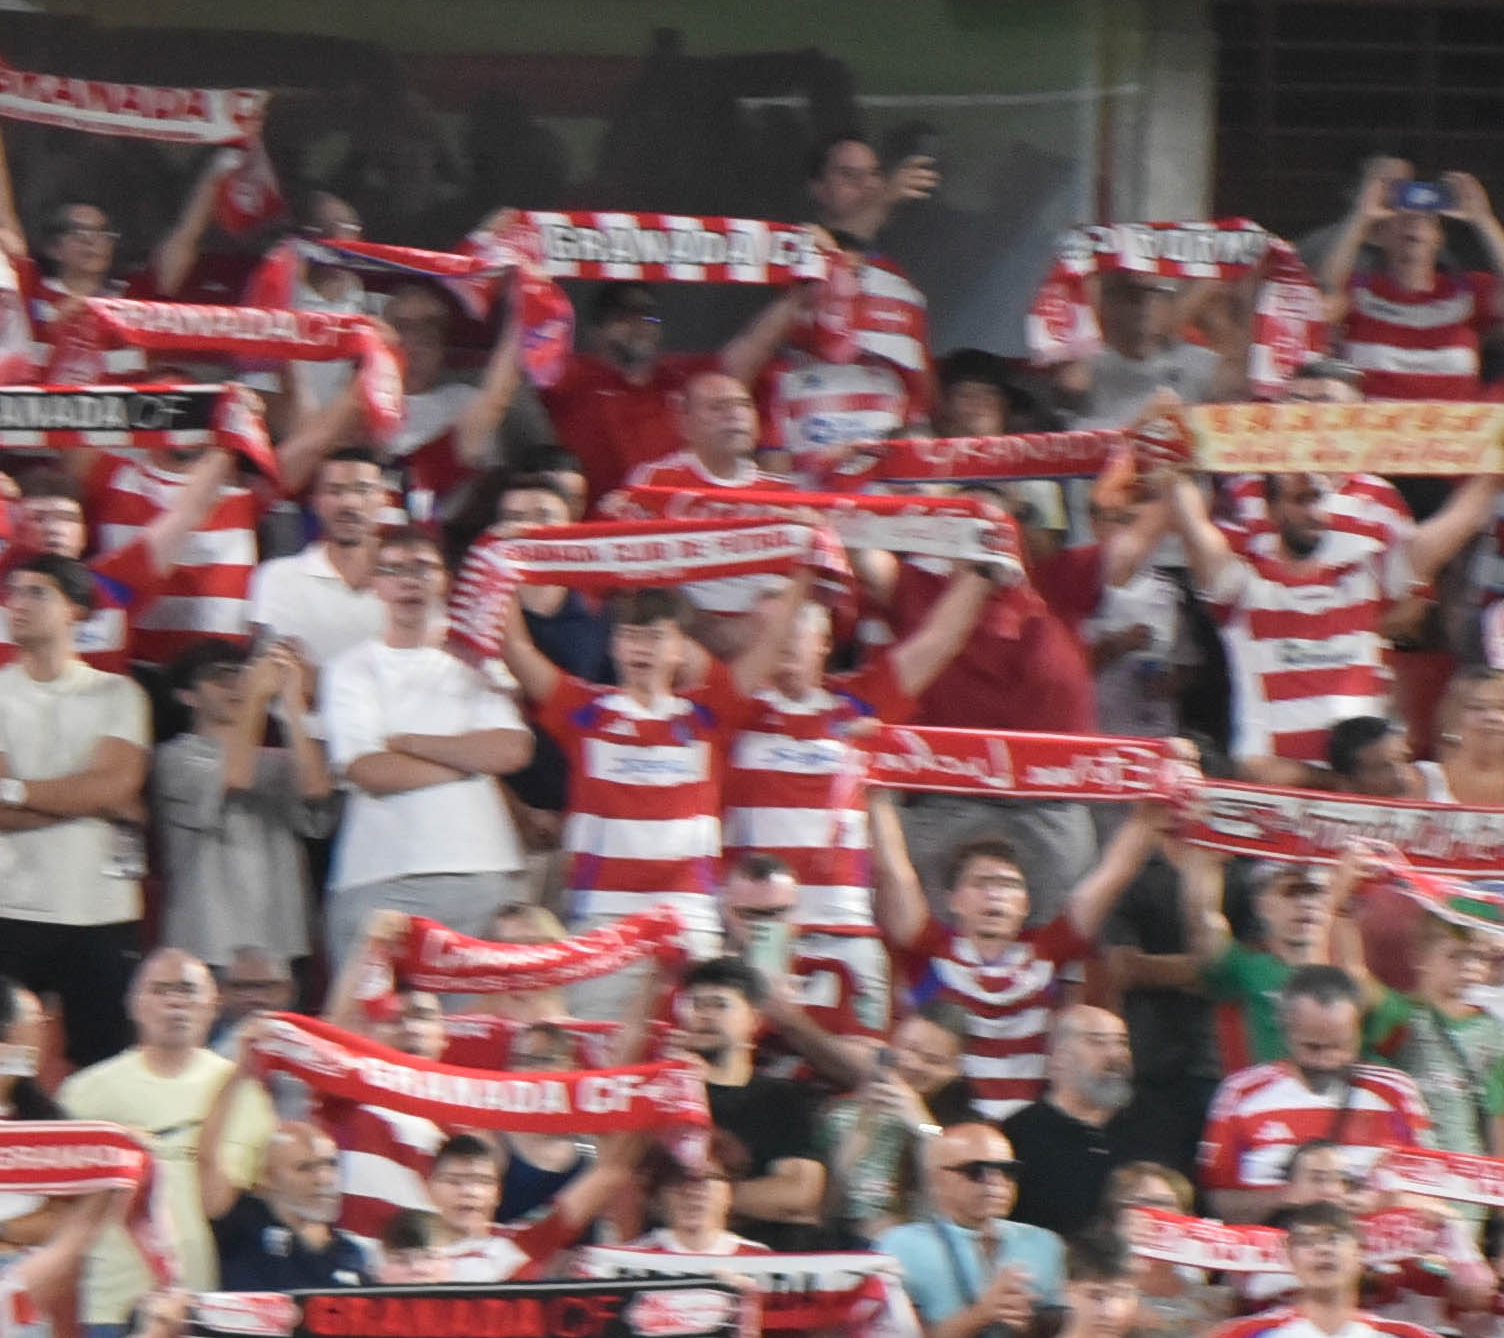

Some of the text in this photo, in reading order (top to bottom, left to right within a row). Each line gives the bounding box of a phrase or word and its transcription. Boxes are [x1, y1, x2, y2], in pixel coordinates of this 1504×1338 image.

[545, 222, 758, 265] GRANADA
[361, 1057, 644, 1111] GRANADA CF
[304, 1295, 620, 1338] GRANADACF
